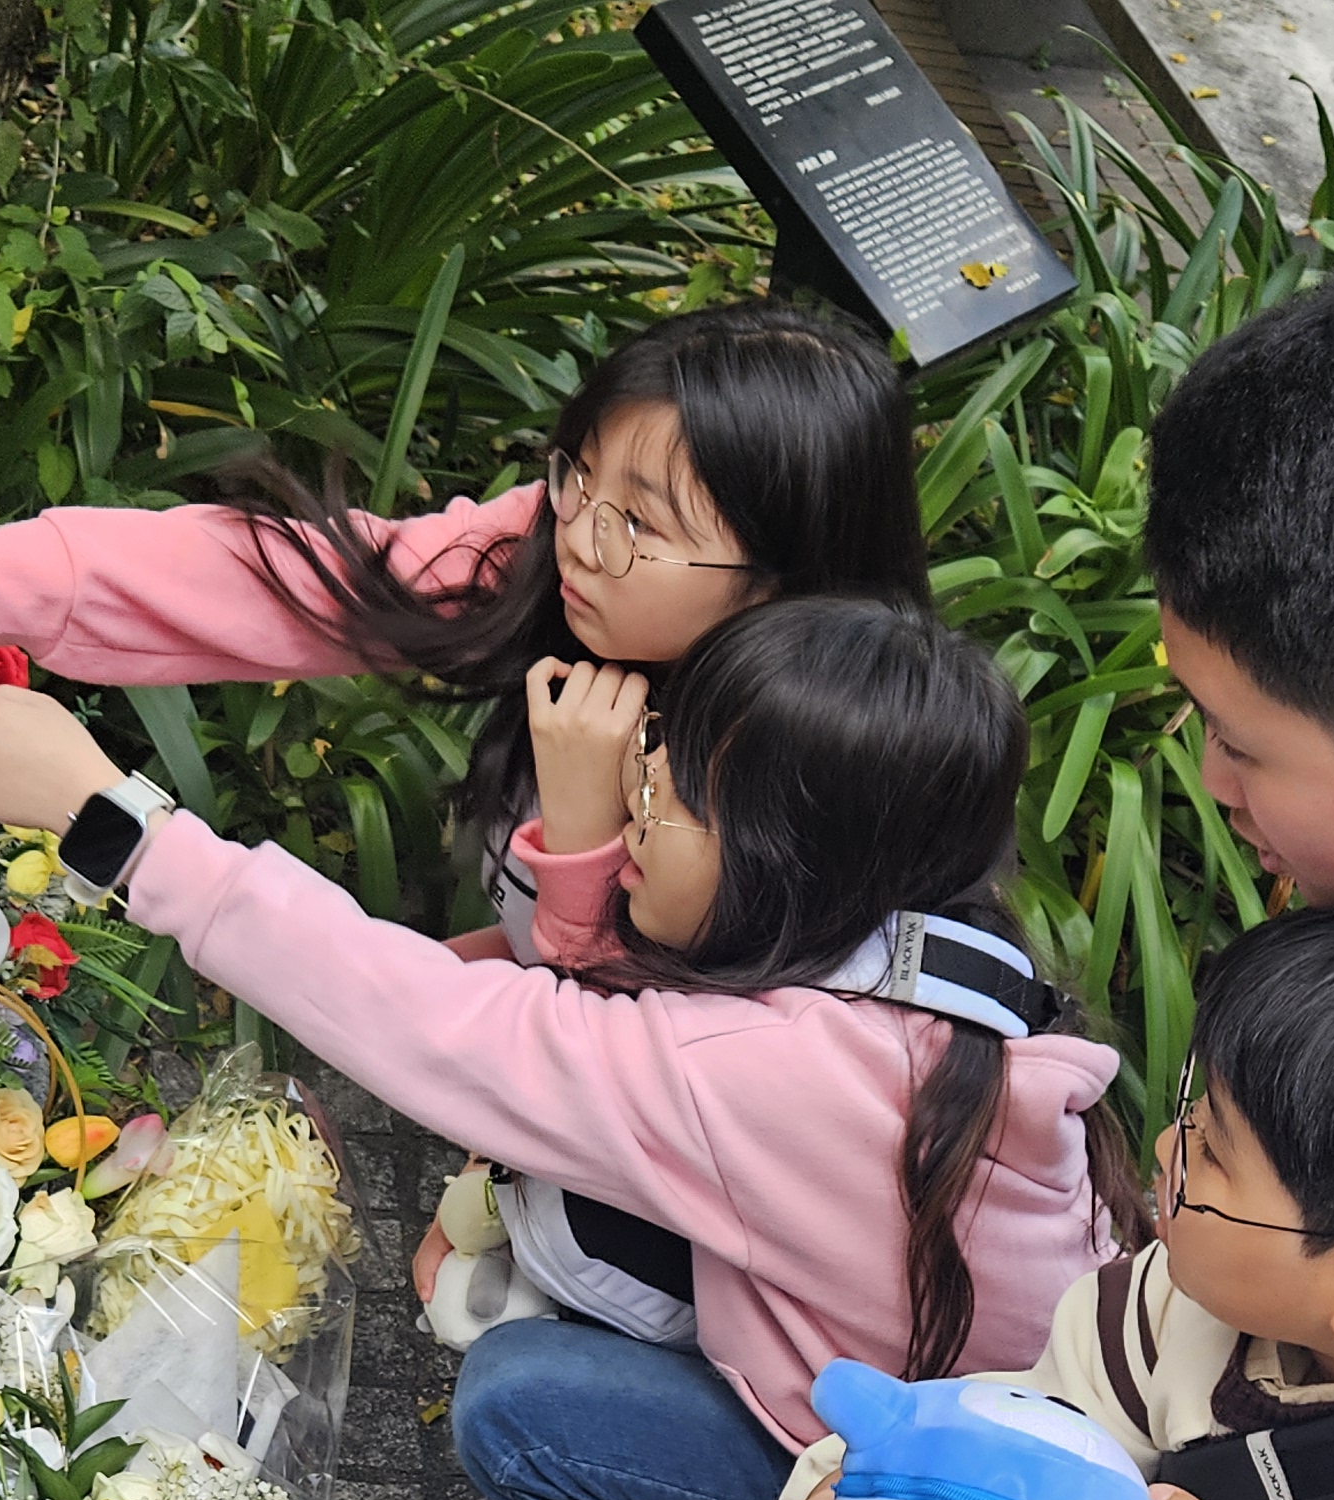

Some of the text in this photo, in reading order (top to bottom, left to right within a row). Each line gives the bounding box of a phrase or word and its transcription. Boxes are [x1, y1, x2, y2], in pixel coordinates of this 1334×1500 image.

[900, 921, 918, 981] BLACK YAK
[1257, 1447, 1275, 1474] YAK
